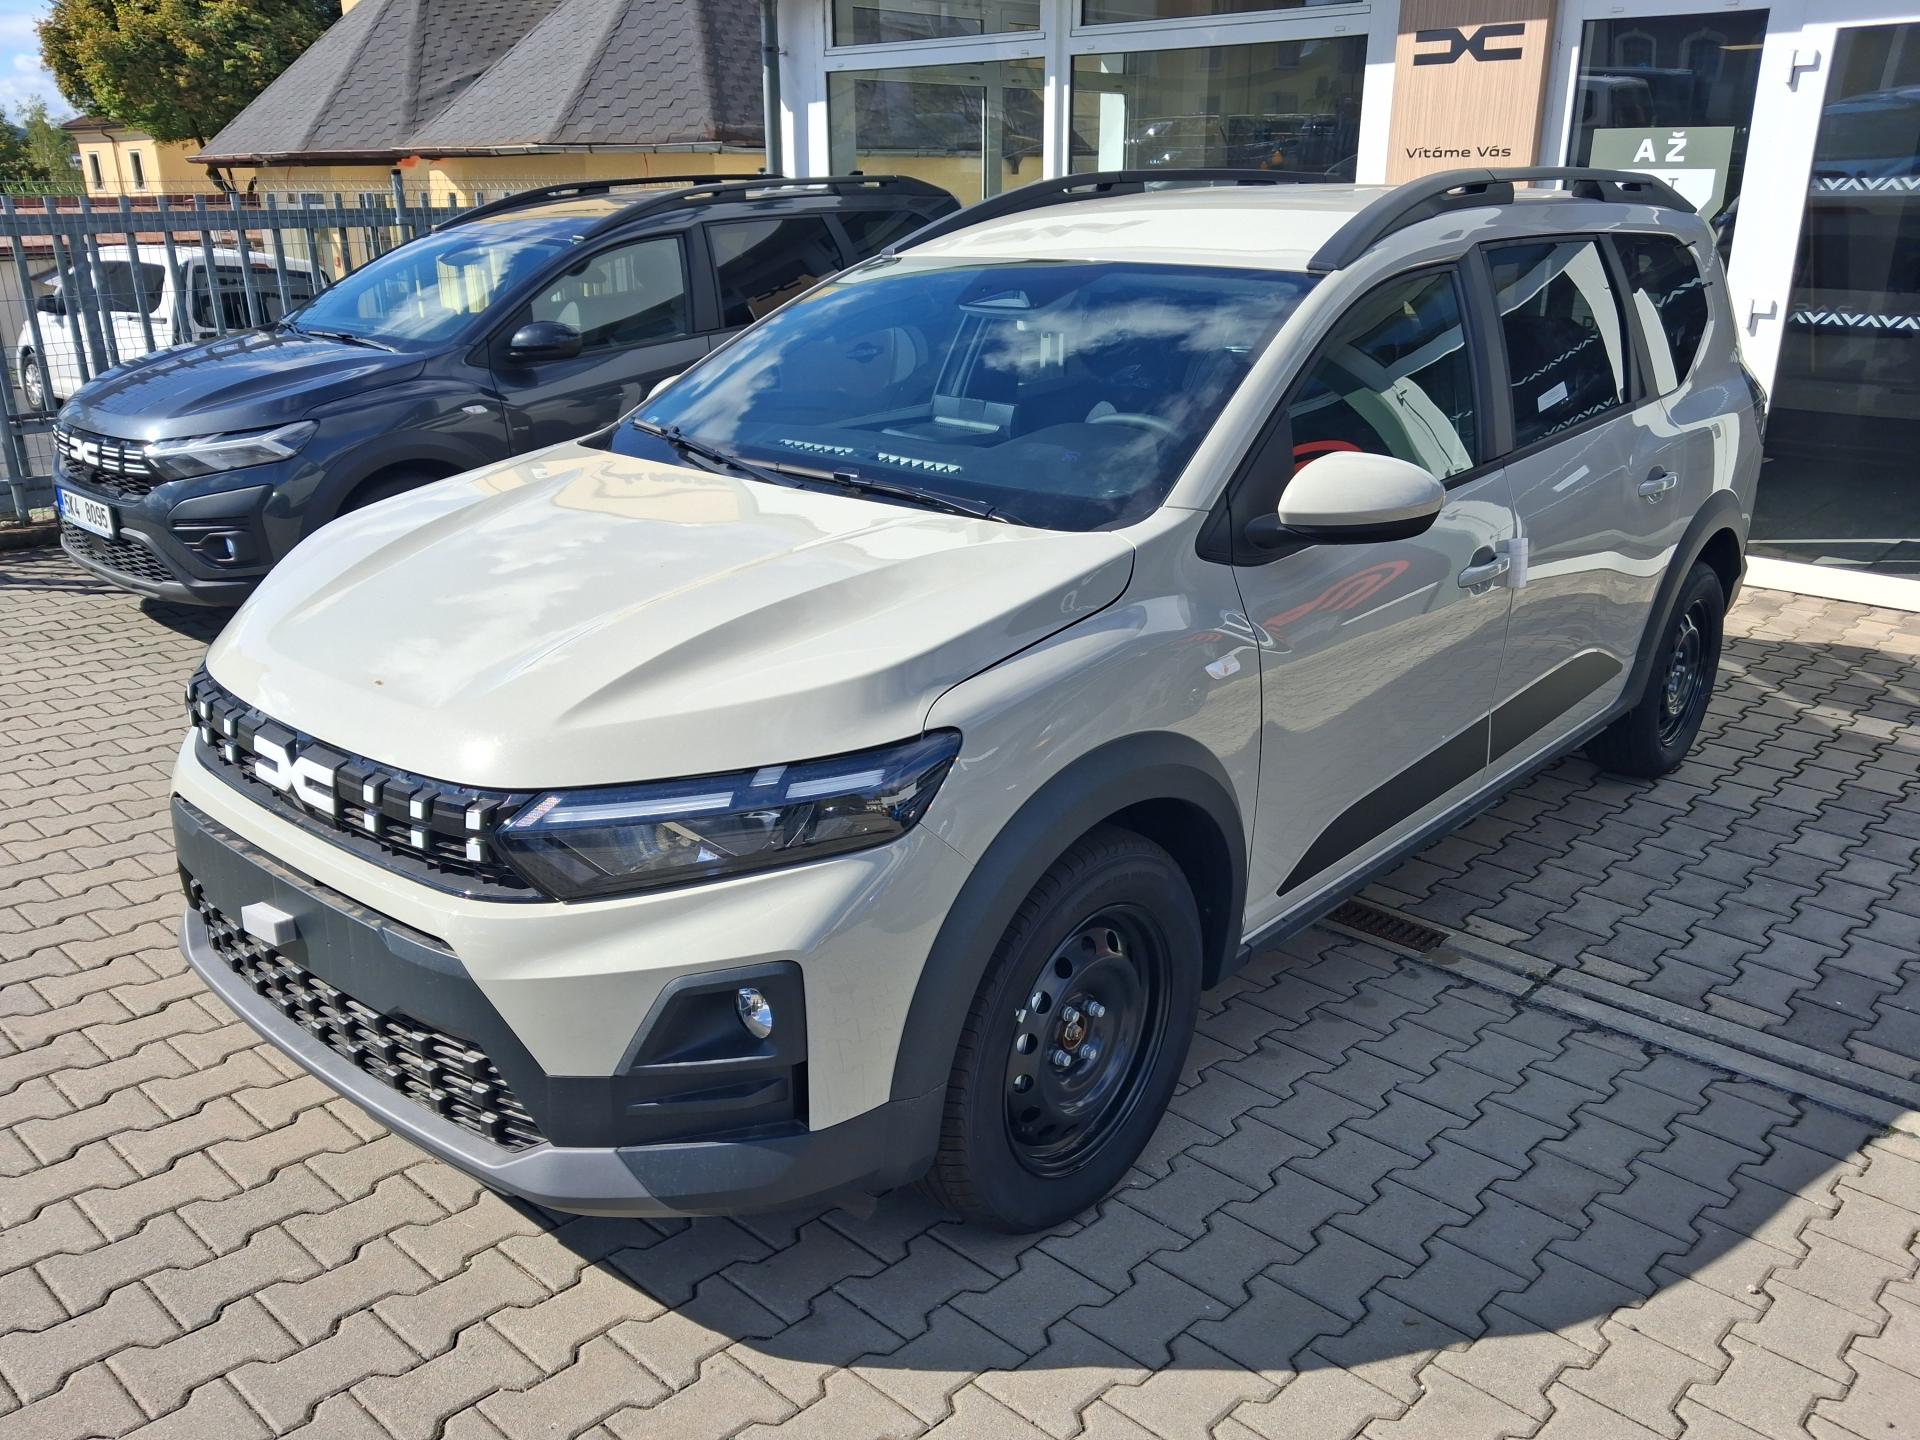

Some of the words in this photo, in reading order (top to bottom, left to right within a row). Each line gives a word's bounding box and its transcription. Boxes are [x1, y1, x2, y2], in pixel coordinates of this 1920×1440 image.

[1406, 147, 1471, 158] Vítáme
[1477, 145, 1511, 157] Vás
[84, 501, 108, 529] 8095
